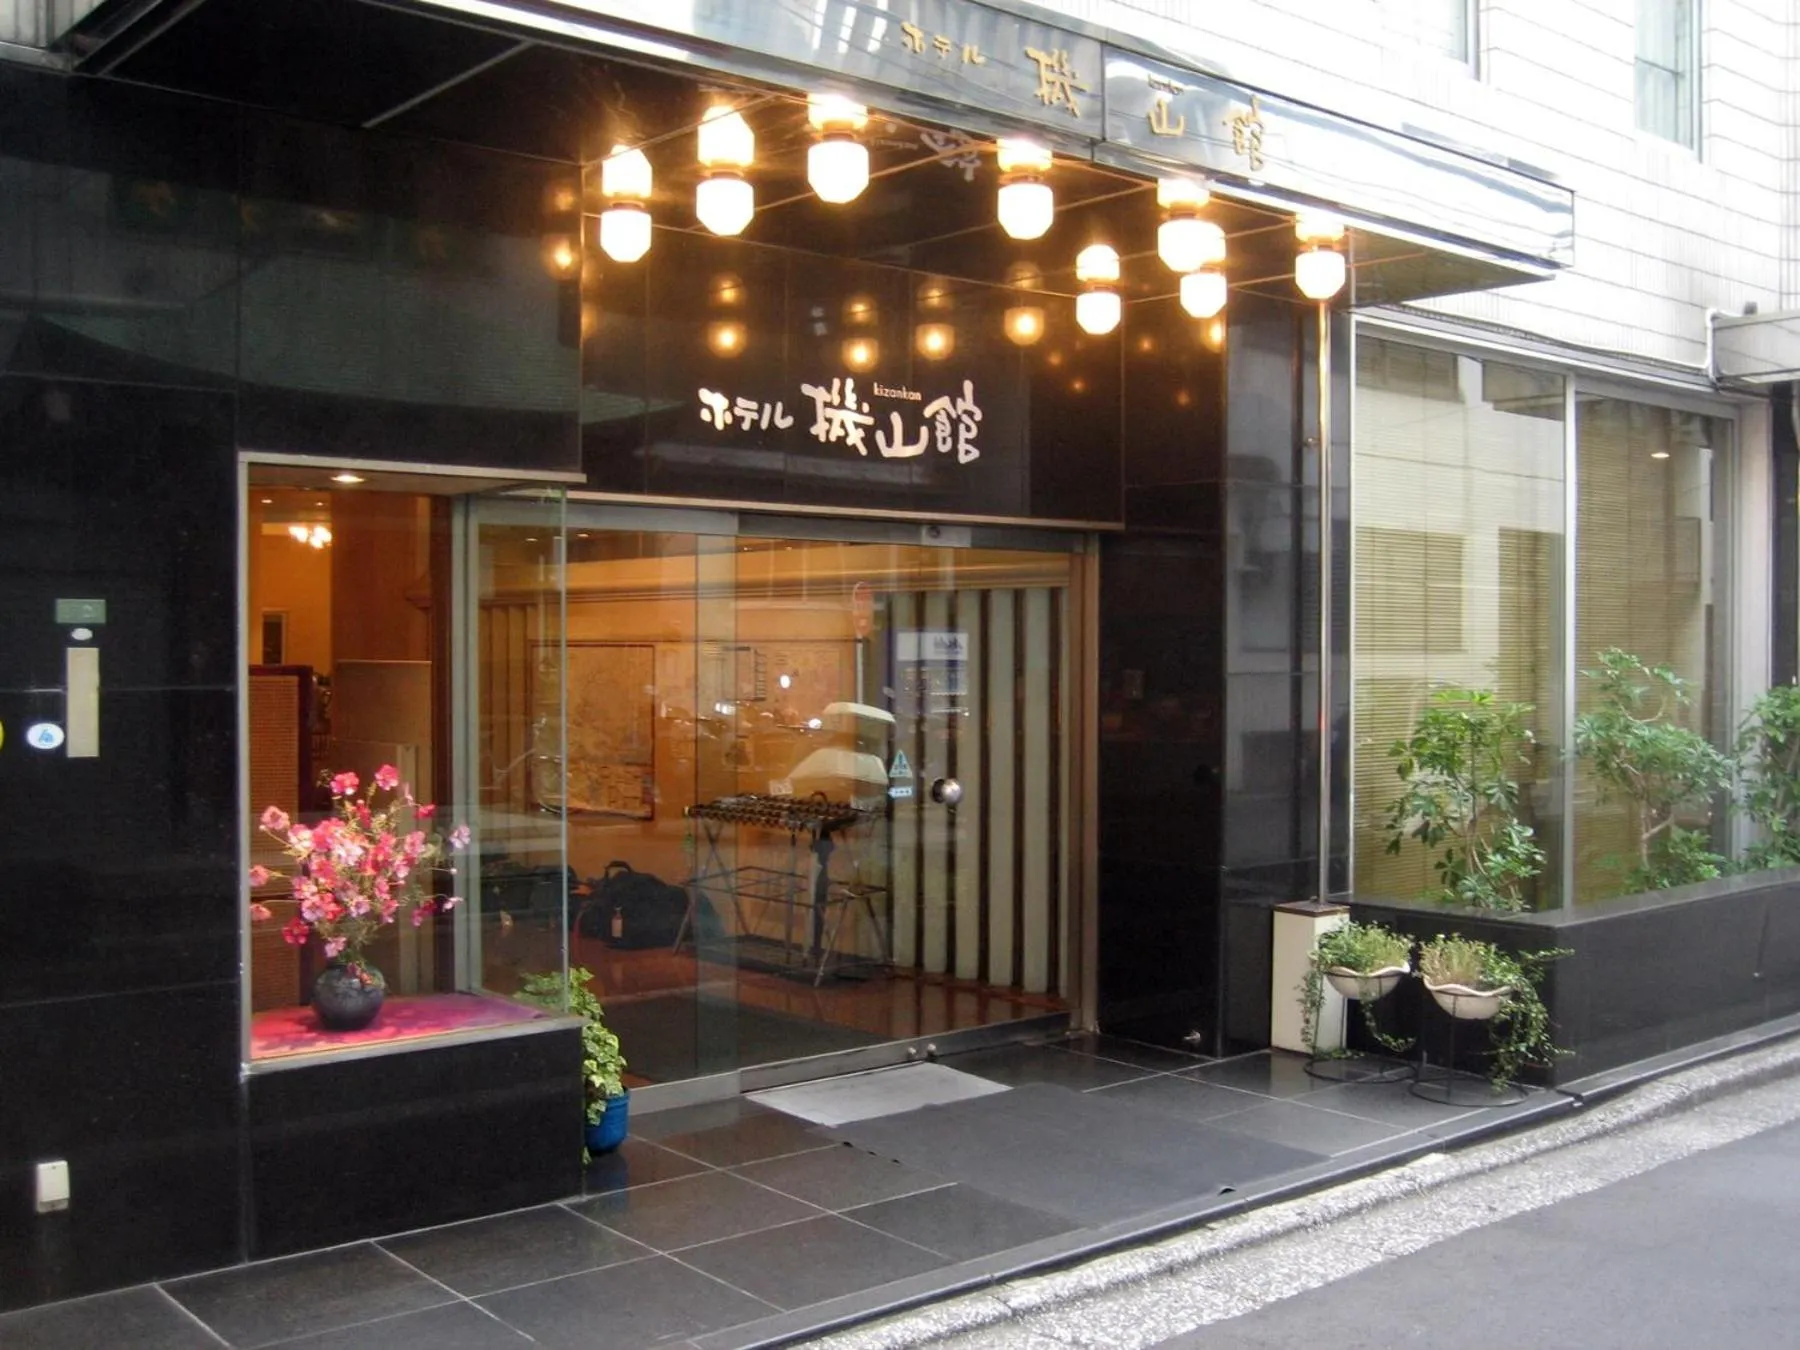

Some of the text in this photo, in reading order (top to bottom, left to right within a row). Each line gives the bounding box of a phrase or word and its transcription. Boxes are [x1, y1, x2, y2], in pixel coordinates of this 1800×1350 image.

[902, 21, 986, 65] ホテル
[698, 387, 794, 431] ホテル
[873, 381, 922, 401] kizankan
